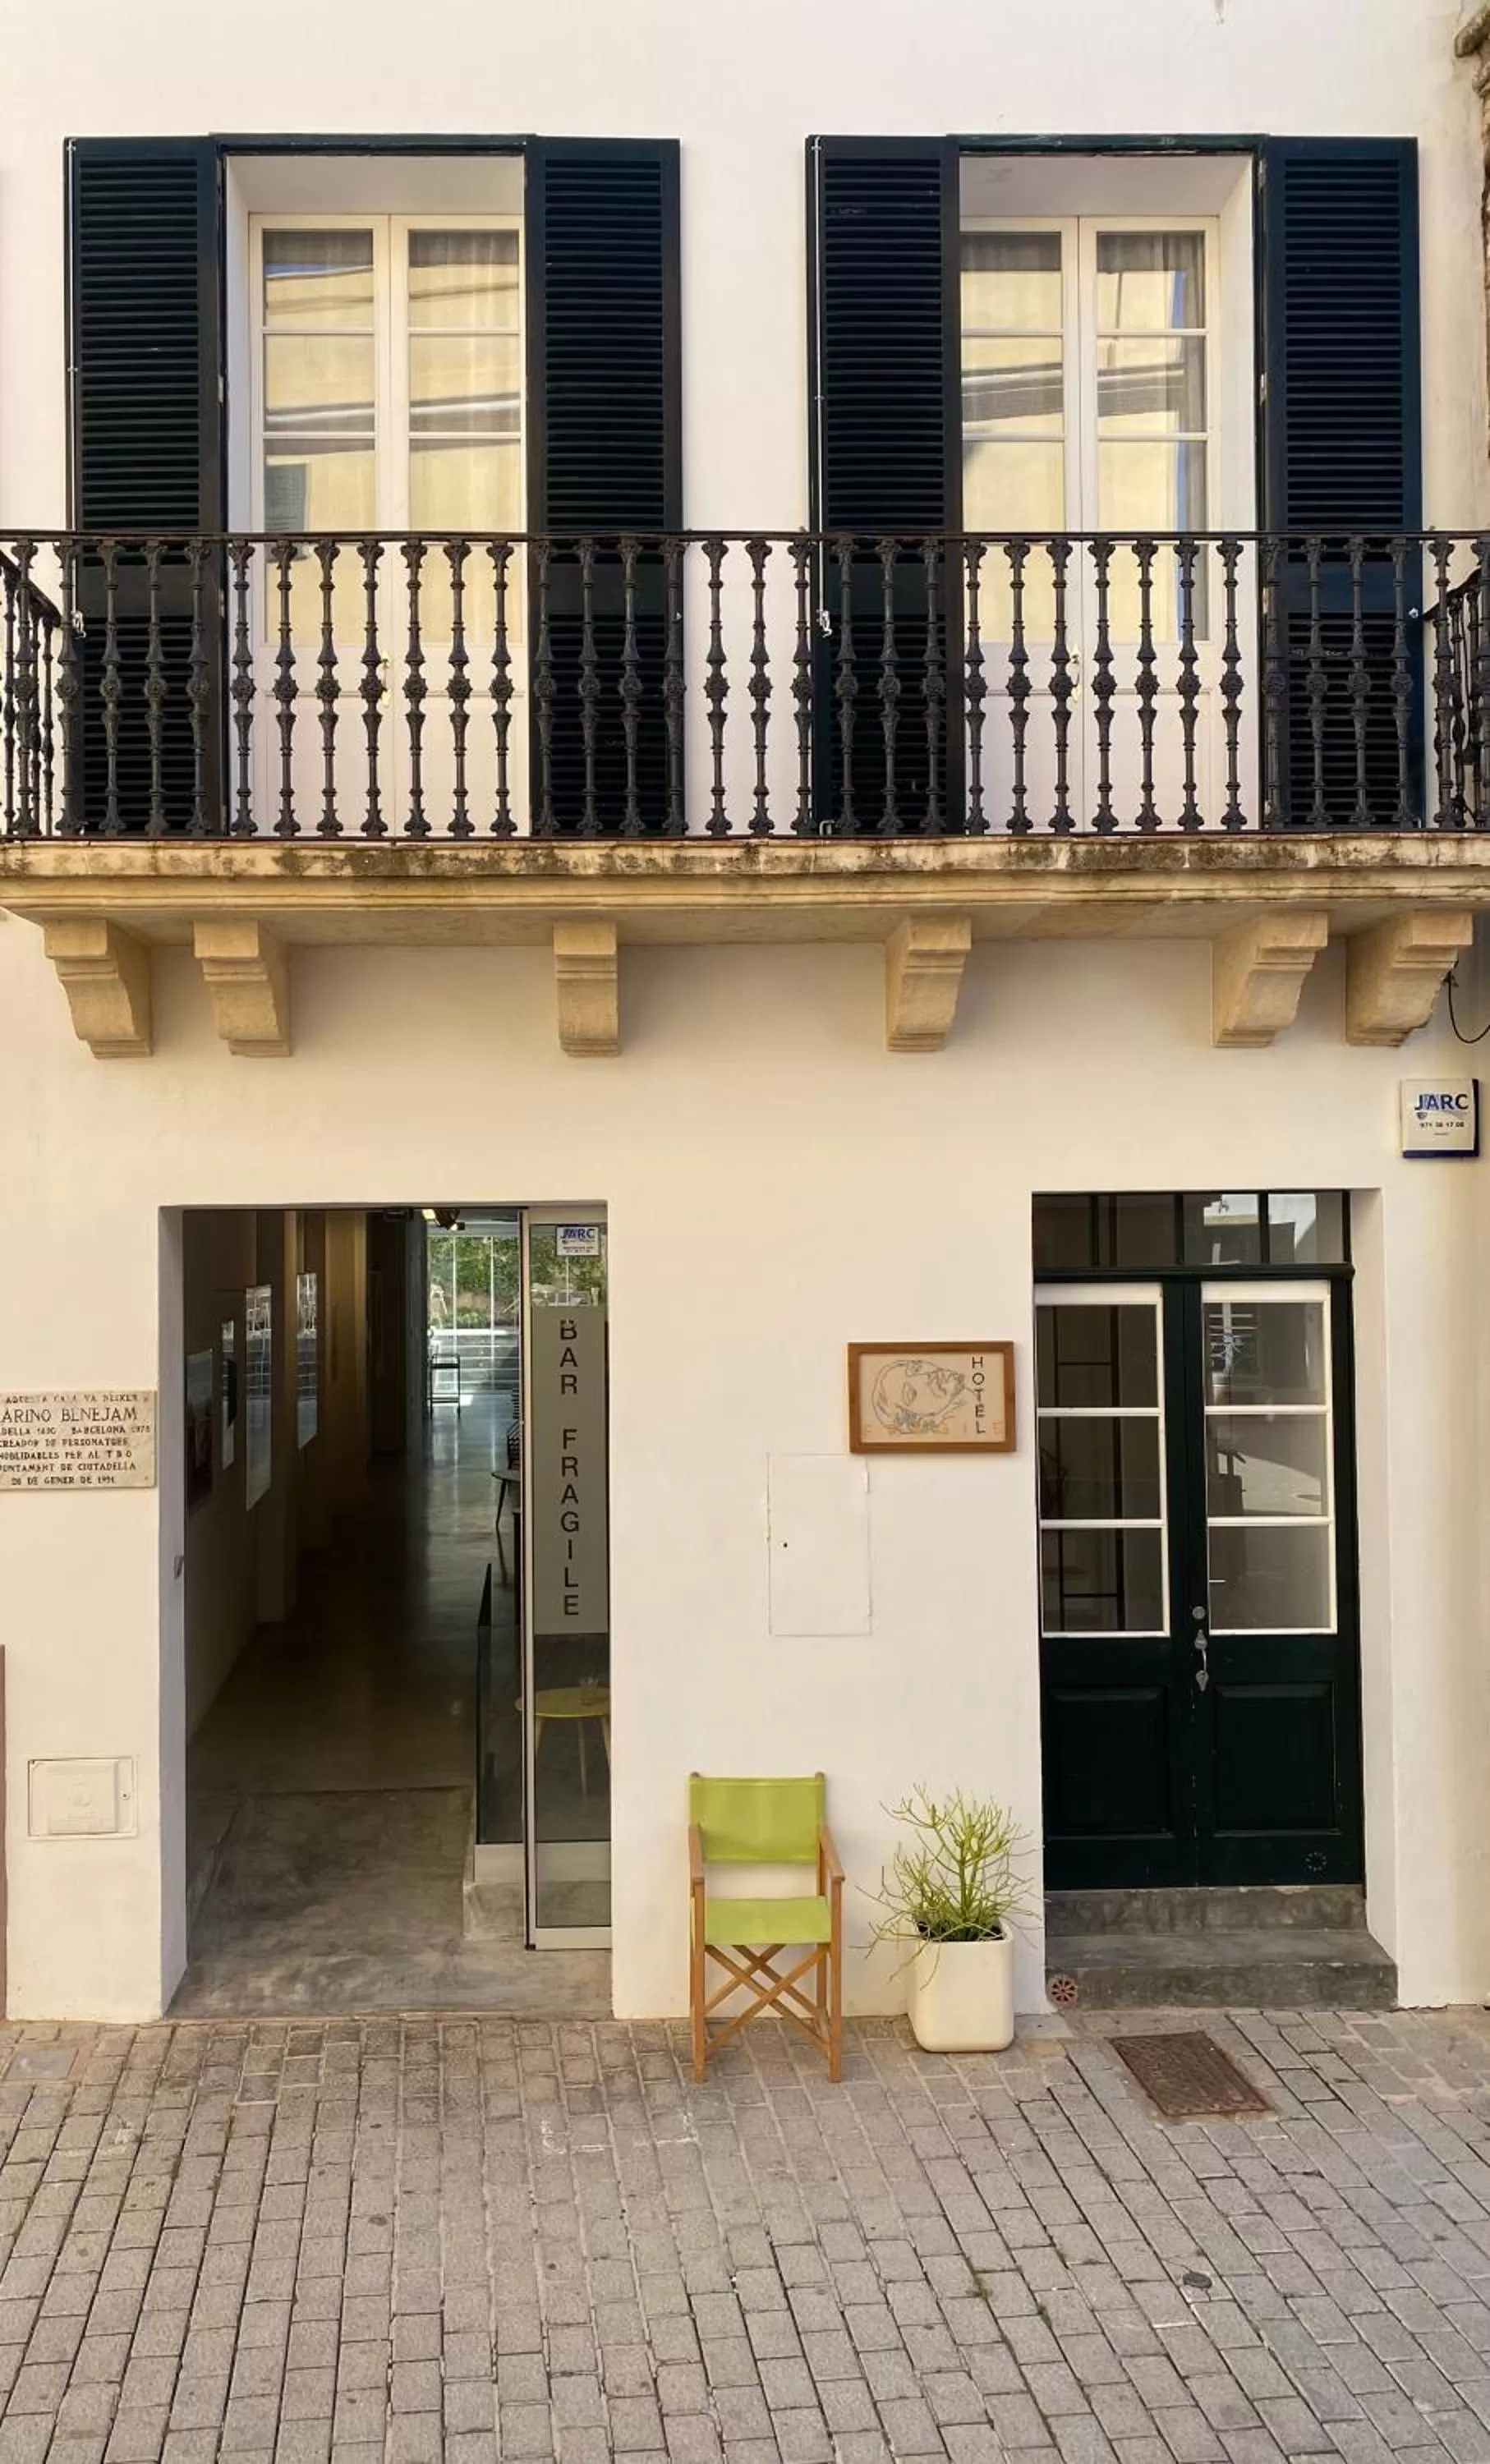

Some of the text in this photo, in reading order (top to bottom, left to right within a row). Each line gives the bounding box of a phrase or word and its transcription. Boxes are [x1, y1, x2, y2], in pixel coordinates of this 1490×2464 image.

[1414, 1093, 1469, 1111] JARC
[560, 1228, 596, 1239] JARC
[972, 1356, 986, 1435] HOTEL
[62, 1406, 138, 1423] BENEJAM
[78, 1462, 137, 1471] CIUTADELLA
[559, 1319, 580, 1617] BAR FRAGILE
